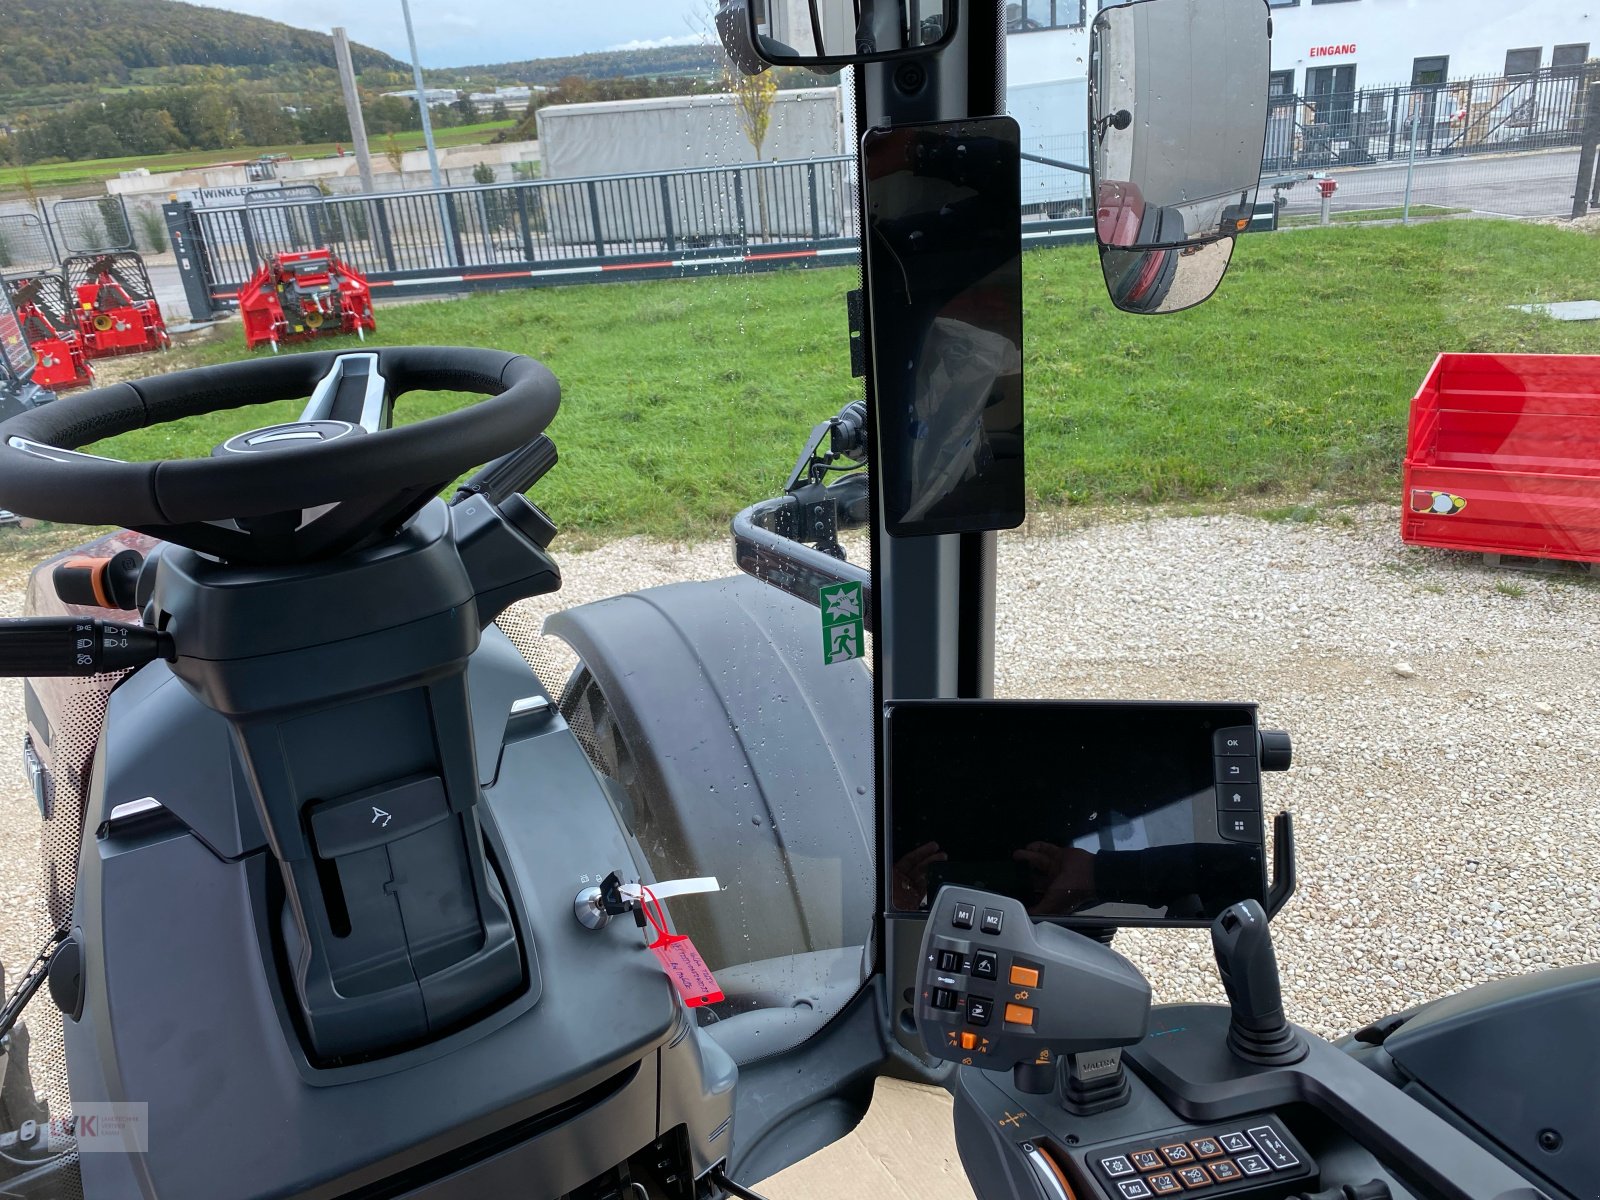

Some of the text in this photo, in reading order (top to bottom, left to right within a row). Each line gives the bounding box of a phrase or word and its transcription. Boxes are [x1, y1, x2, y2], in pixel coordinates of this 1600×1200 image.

[1309, 44, 1357, 58] EINGANG
[958, 911, 970, 920] M1
[987, 916, 998, 925] M2
[1082, 1058, 1116, 1073] VALTRA
[1148, 1153, 1154, 1161] 1
[1165, 1177, 1171, 1185] 2
[1129, 1185, 1142, 1194] M3
